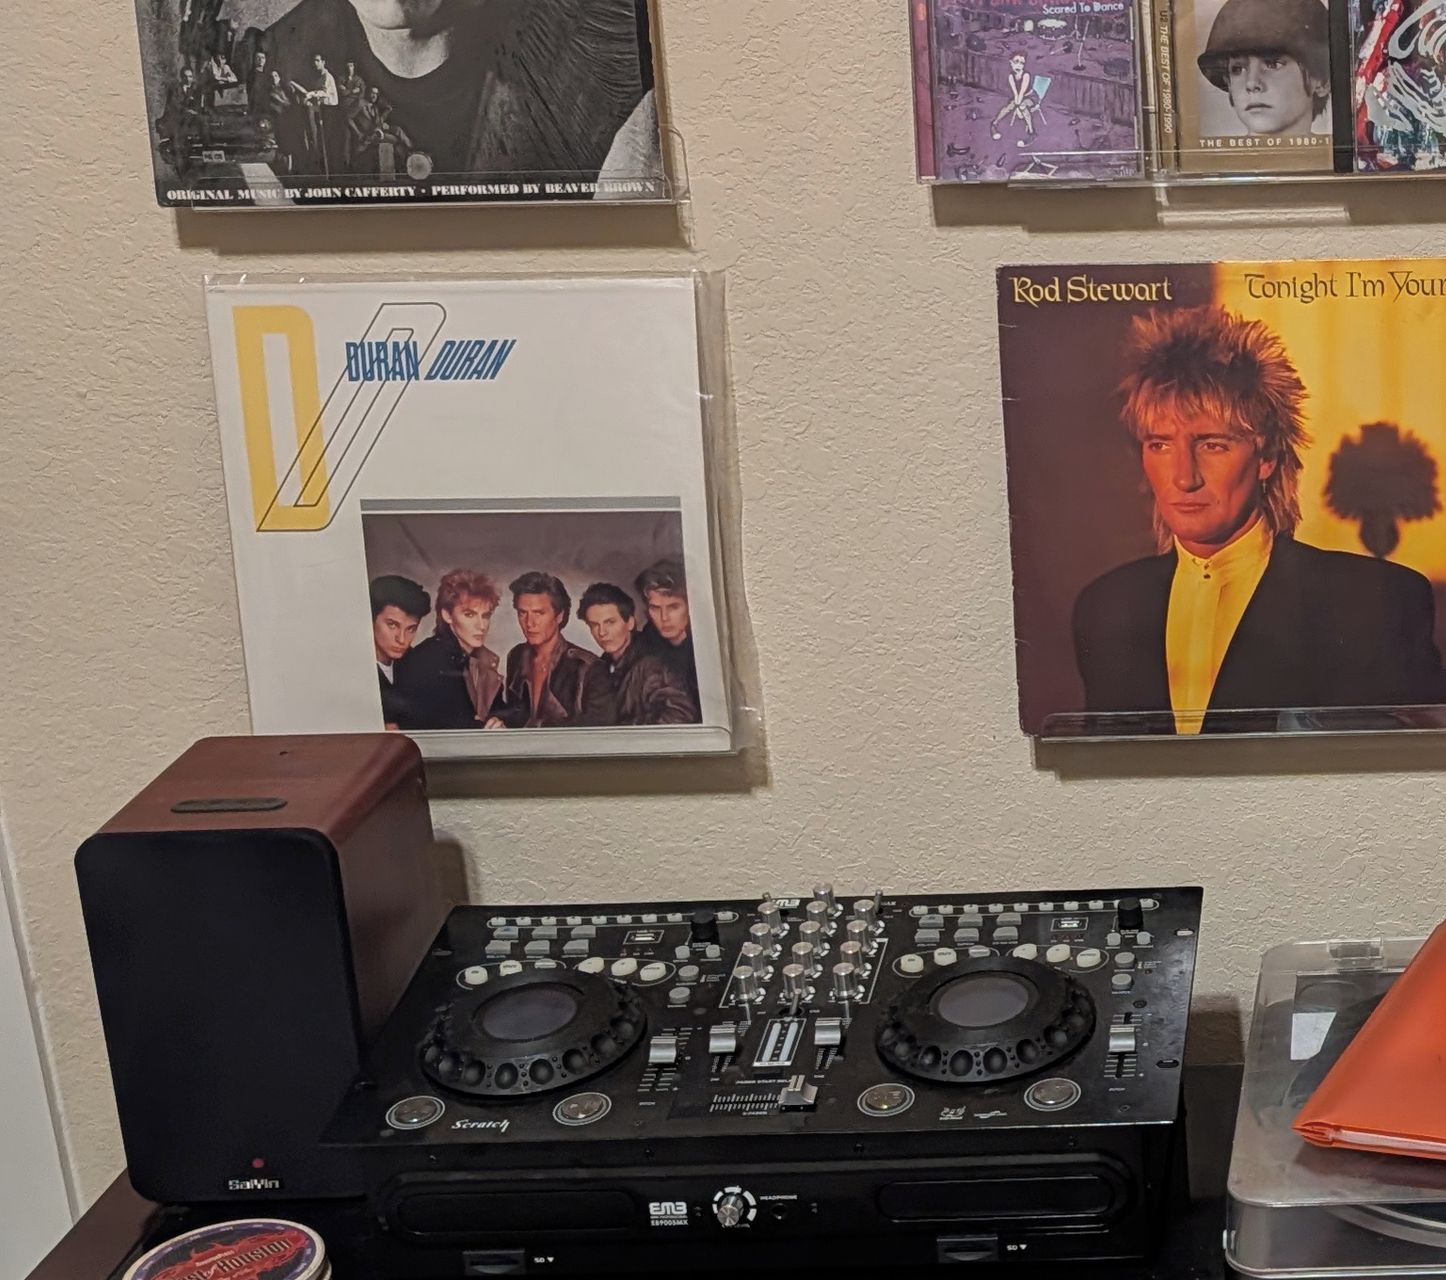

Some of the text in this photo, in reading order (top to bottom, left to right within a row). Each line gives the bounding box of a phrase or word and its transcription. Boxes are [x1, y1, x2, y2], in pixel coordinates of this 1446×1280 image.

[1042, 1, 1124, 15] Scared To Dance
[1160, 25, 1169, 44] THE
[1160, 45, 1170, 70] BEST
[1161, 71, 1171, 85] OF
[1199, 136, 1329, 148] THE BEST OF 1980-1
[166, 181, 655, 201] ORIGINAL MUSIC BY JOHN CAFFERTY PERFORMED BY BEAVER BROWN
[1009, 275, 1061, 308] Rod
[1066, 275, 1172, 304] Stewart
[1244, 272, 1339, 304] Tonight
[1345, 271, 1385, 297] I'm
[345, 338, 517, 382] DURAN DURAN
[451, 1119, 511, 1133] Scratch
[216, 1239, 292, 1275] Houston
